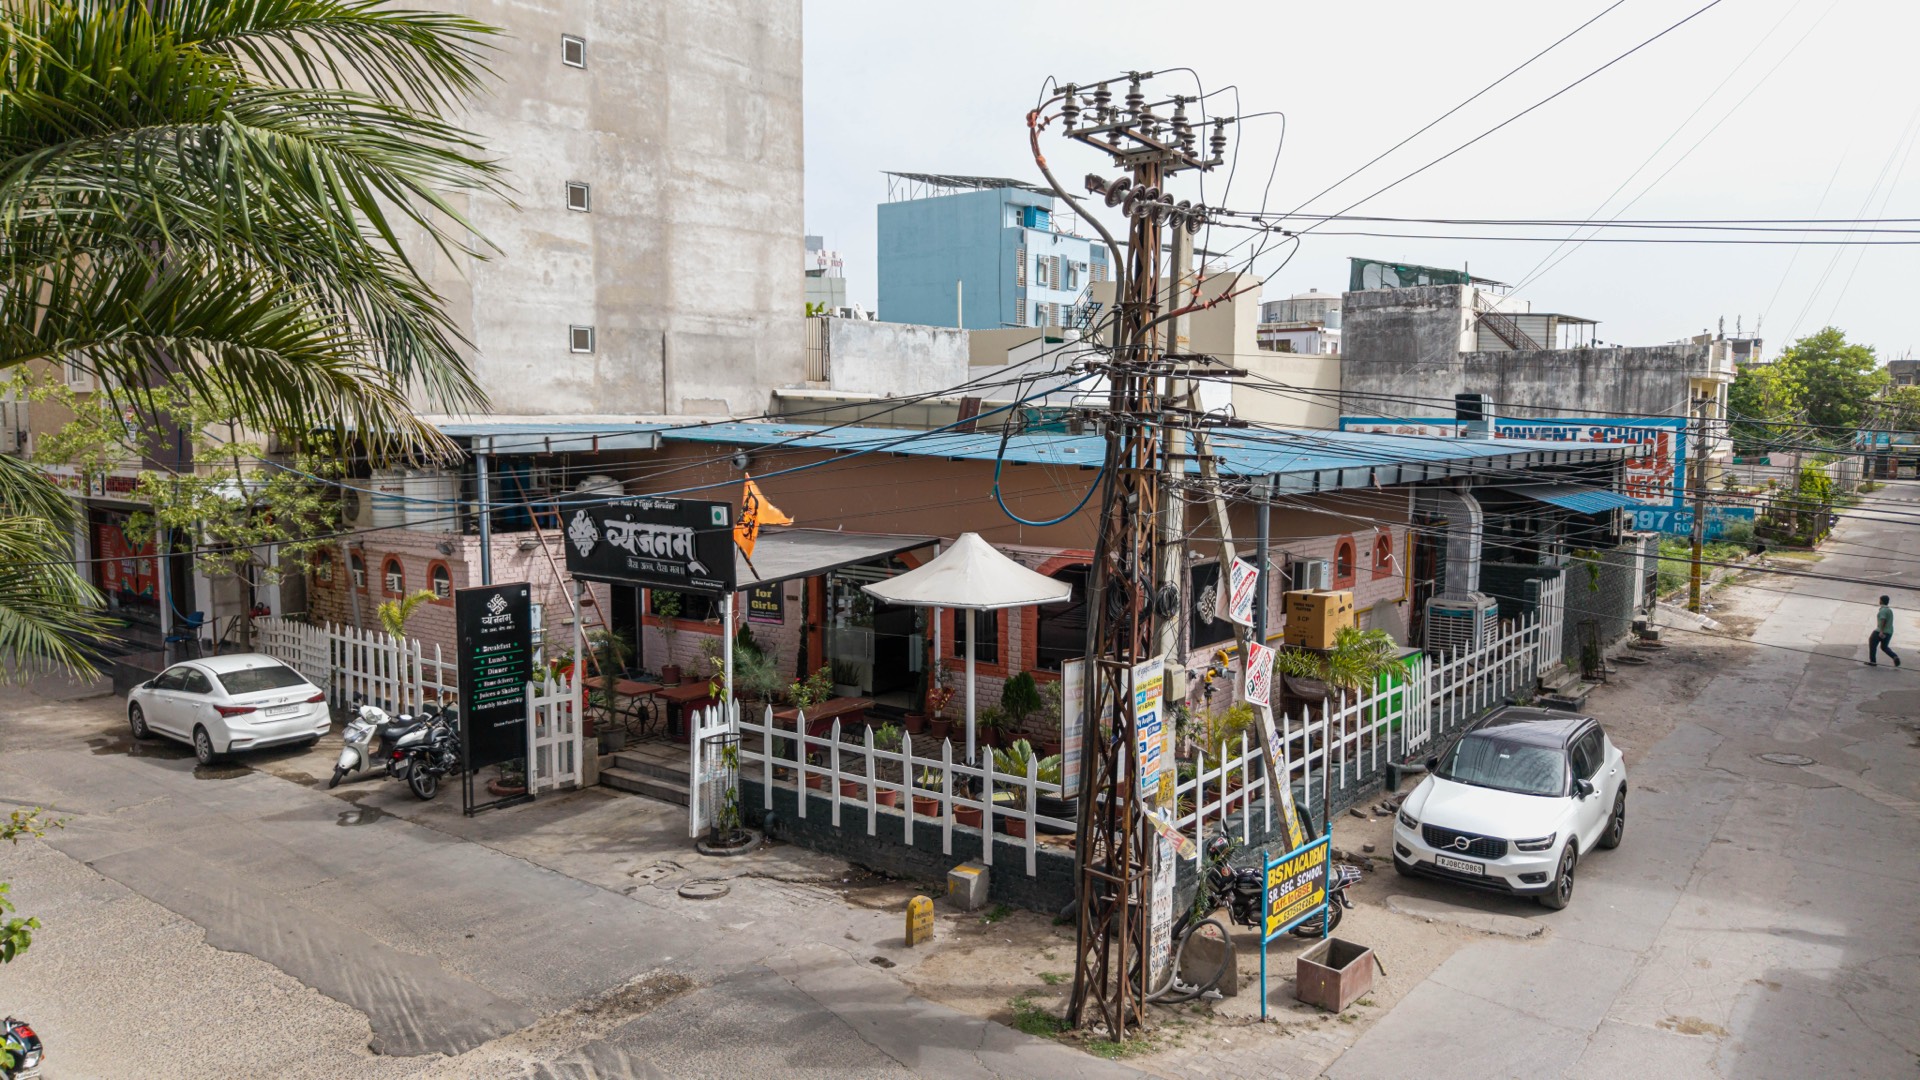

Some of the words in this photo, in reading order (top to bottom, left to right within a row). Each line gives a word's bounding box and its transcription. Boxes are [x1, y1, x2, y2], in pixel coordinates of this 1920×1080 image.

[755, 588, 772, 598] for
[751, 601, 778, 610] Girls
[482, 643, 511, 652] Breakfast
[488, 655, 507, 664] Lunch
[487, 666, 508, 675] Dinner
[479, 690, 496, 700] Juices
[501, 686, 520, 695] Shakes
[477, 701, 496, 711] Monthly
[496, 697, 523, 706] Membership
[1296, 864, 1323, 887] SCHOOL
